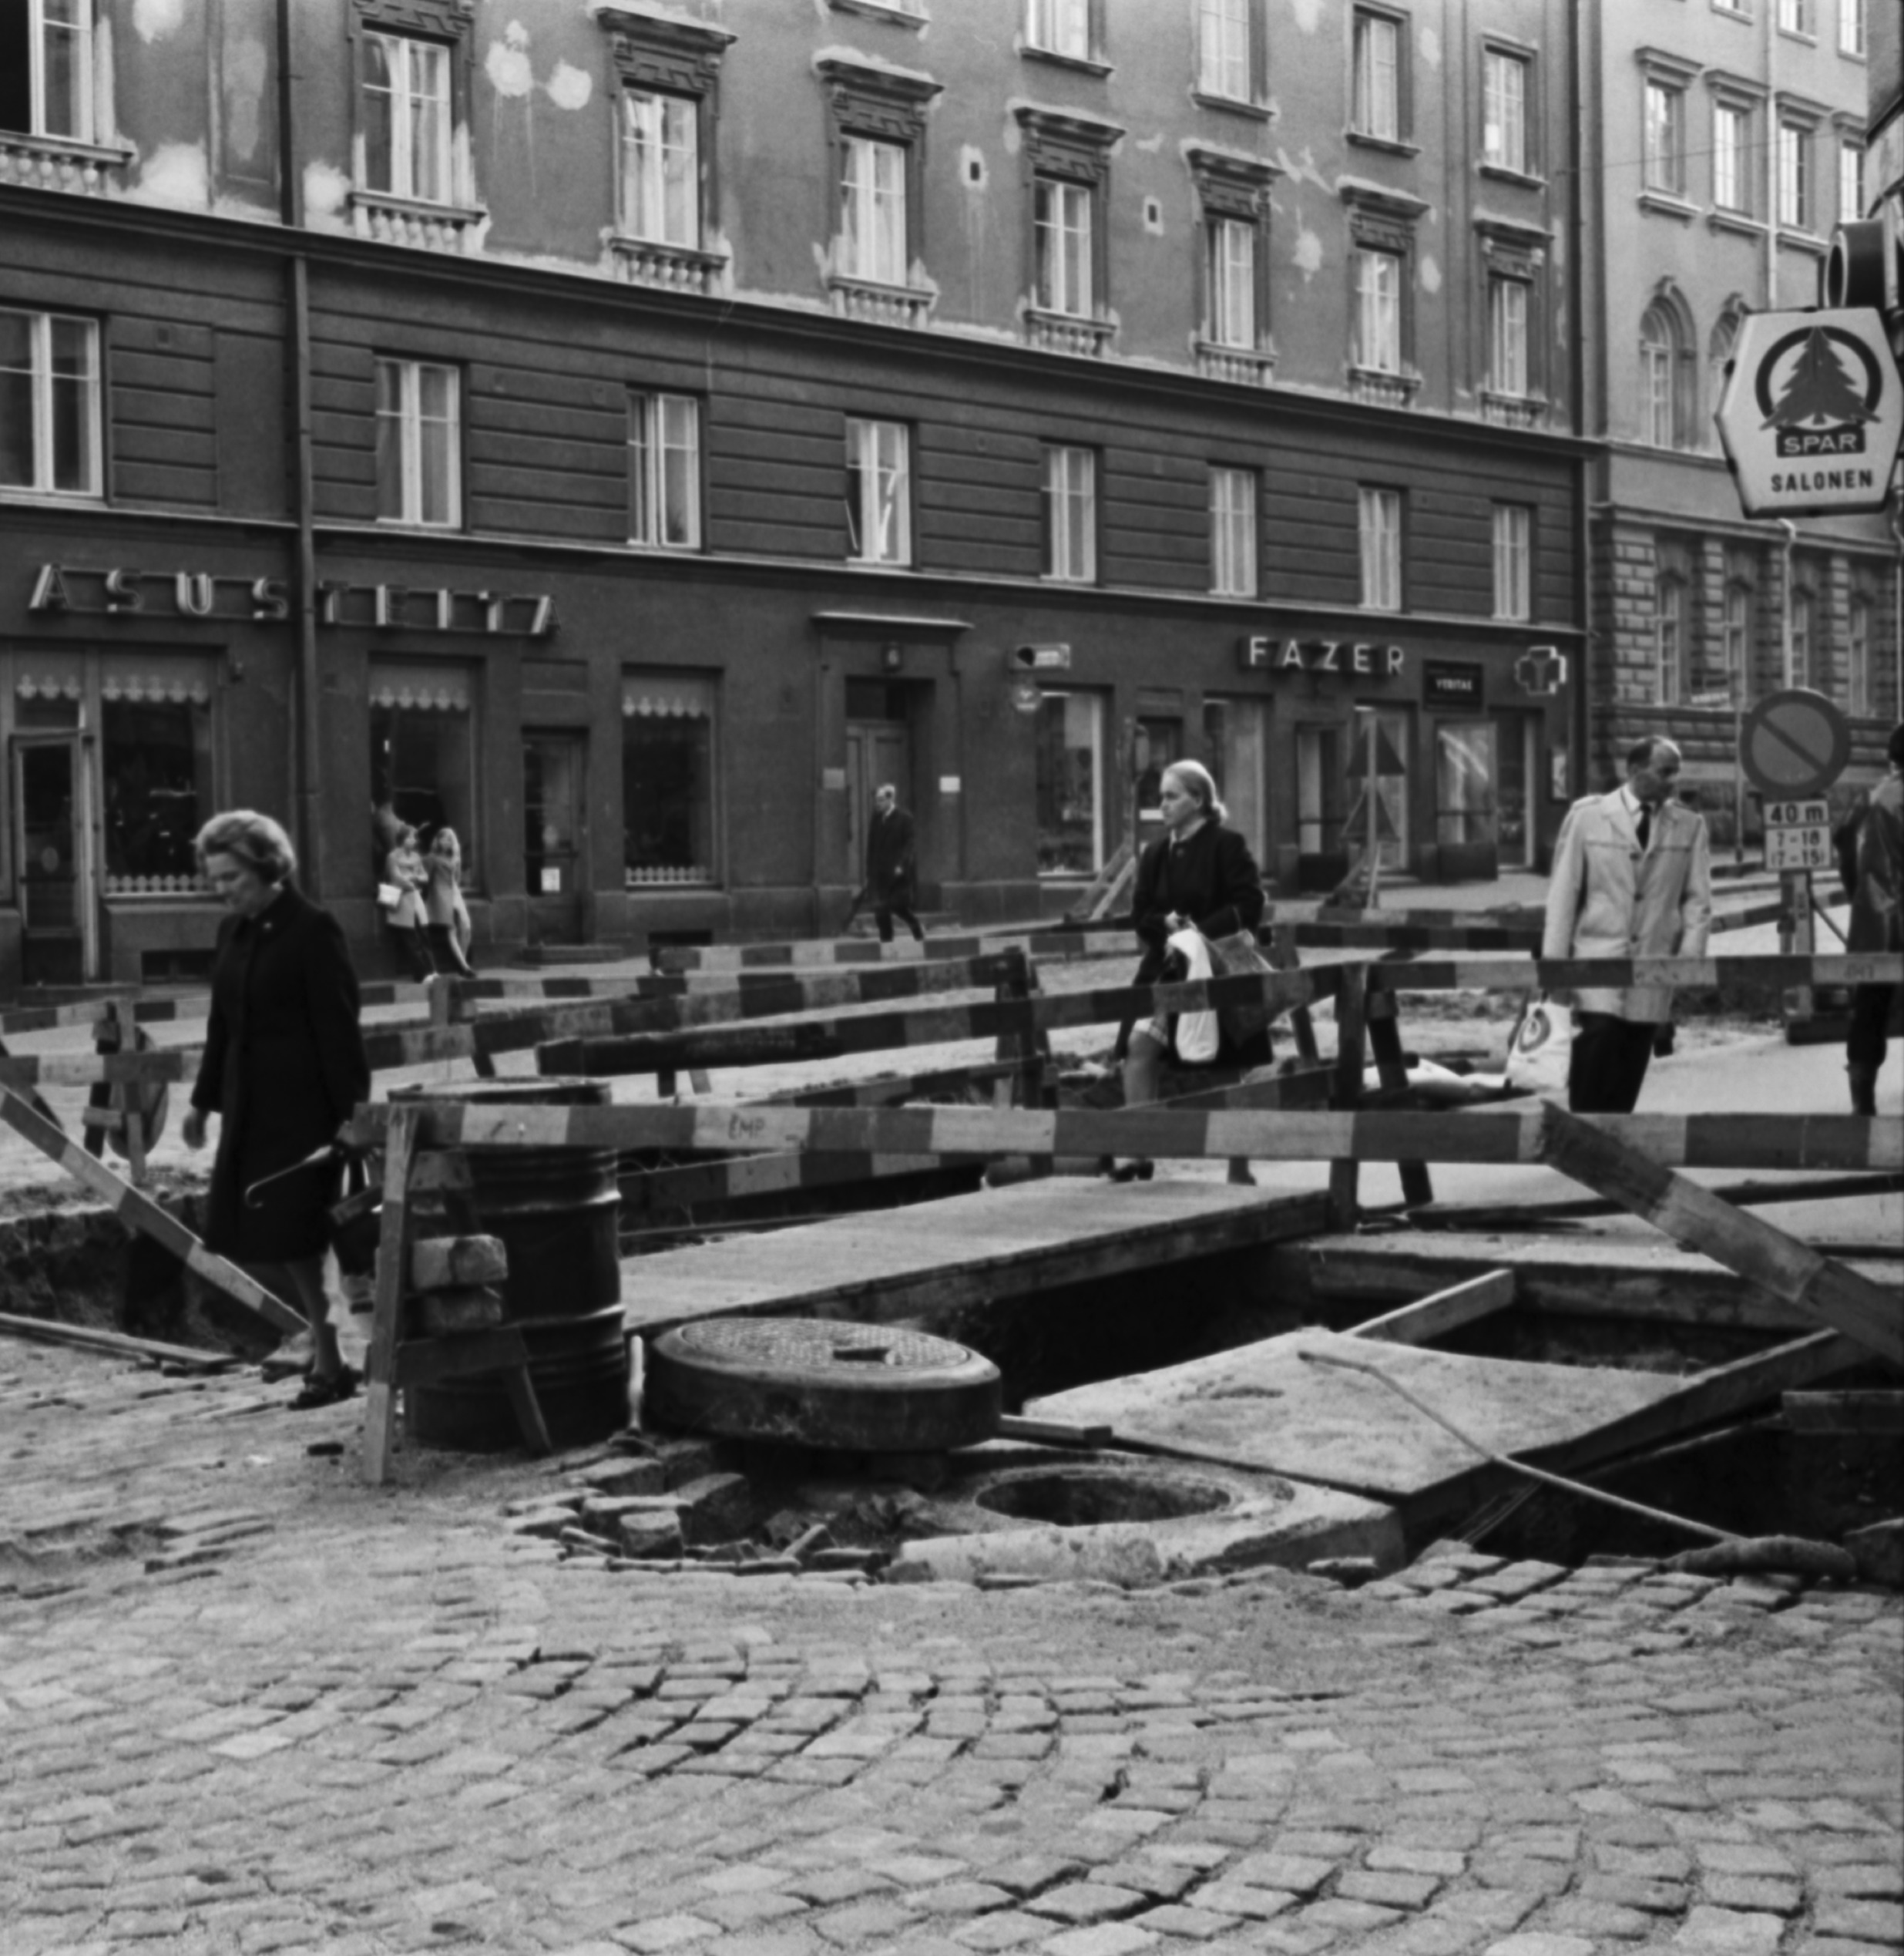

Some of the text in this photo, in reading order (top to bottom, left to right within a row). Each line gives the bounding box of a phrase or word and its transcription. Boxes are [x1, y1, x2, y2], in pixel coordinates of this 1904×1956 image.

[1784, 433, 1858, 455] SPAR
[1770, 469, 1874, 492] SALONEN
[1249, 636, 1405, 674] FAZER
[1771, 803, 1824, 824] 40 m
